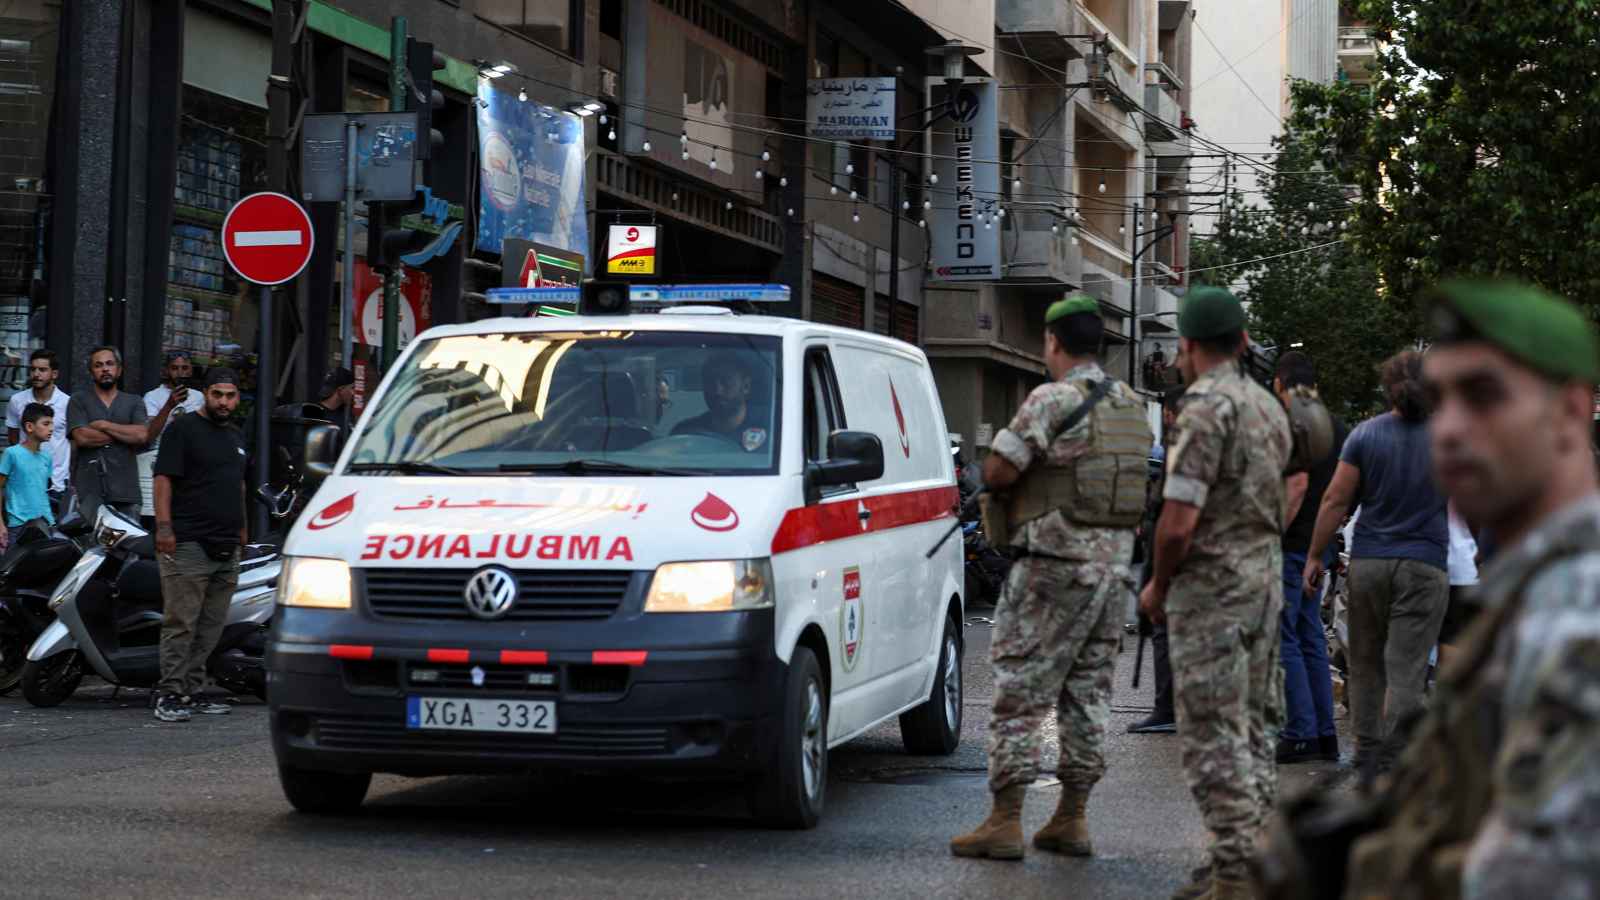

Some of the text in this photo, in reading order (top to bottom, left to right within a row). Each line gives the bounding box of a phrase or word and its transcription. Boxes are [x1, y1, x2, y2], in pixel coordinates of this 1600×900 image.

[816, 115, 889, 127] MARIGNAN
[424, 700, 549, 729] XGA 332
